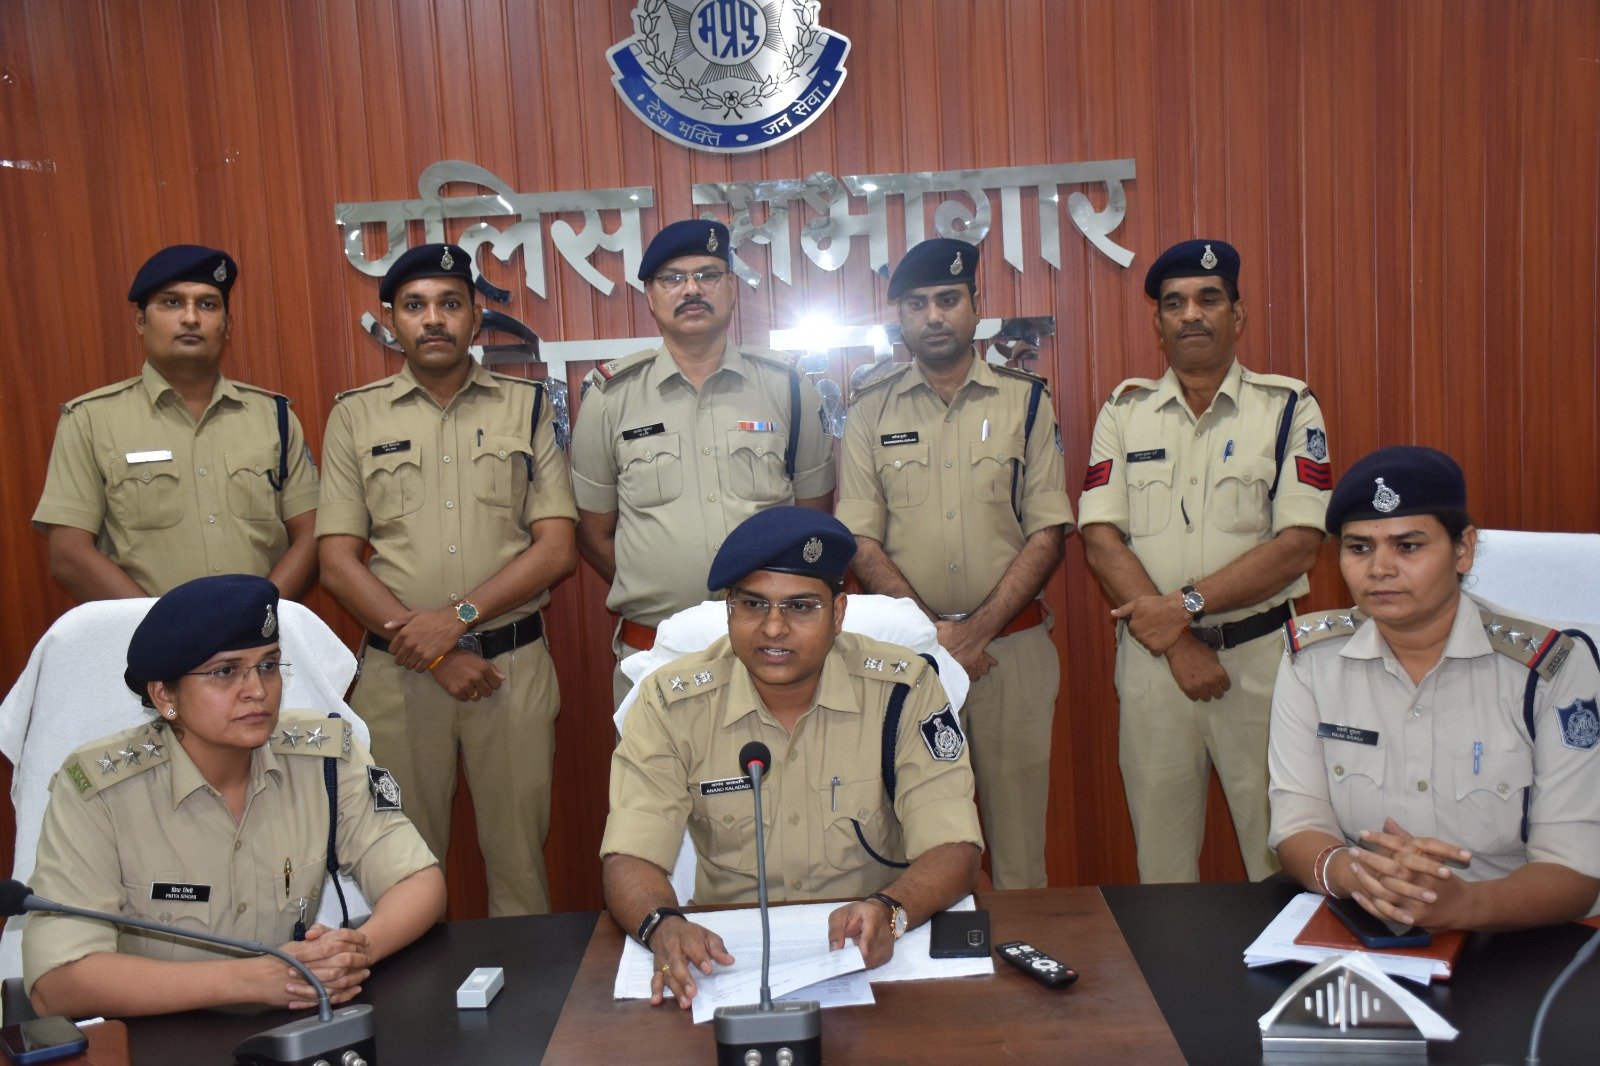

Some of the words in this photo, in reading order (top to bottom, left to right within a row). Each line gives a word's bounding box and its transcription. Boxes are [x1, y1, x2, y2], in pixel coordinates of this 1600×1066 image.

[646, 98, 674, 126] देश
[678, 121, 722, 146] भक्ति
[761, 113, 793, 135] जन
[791, 86, 826, 116] सेवा
[335, 159, 654, 305] पलिस
